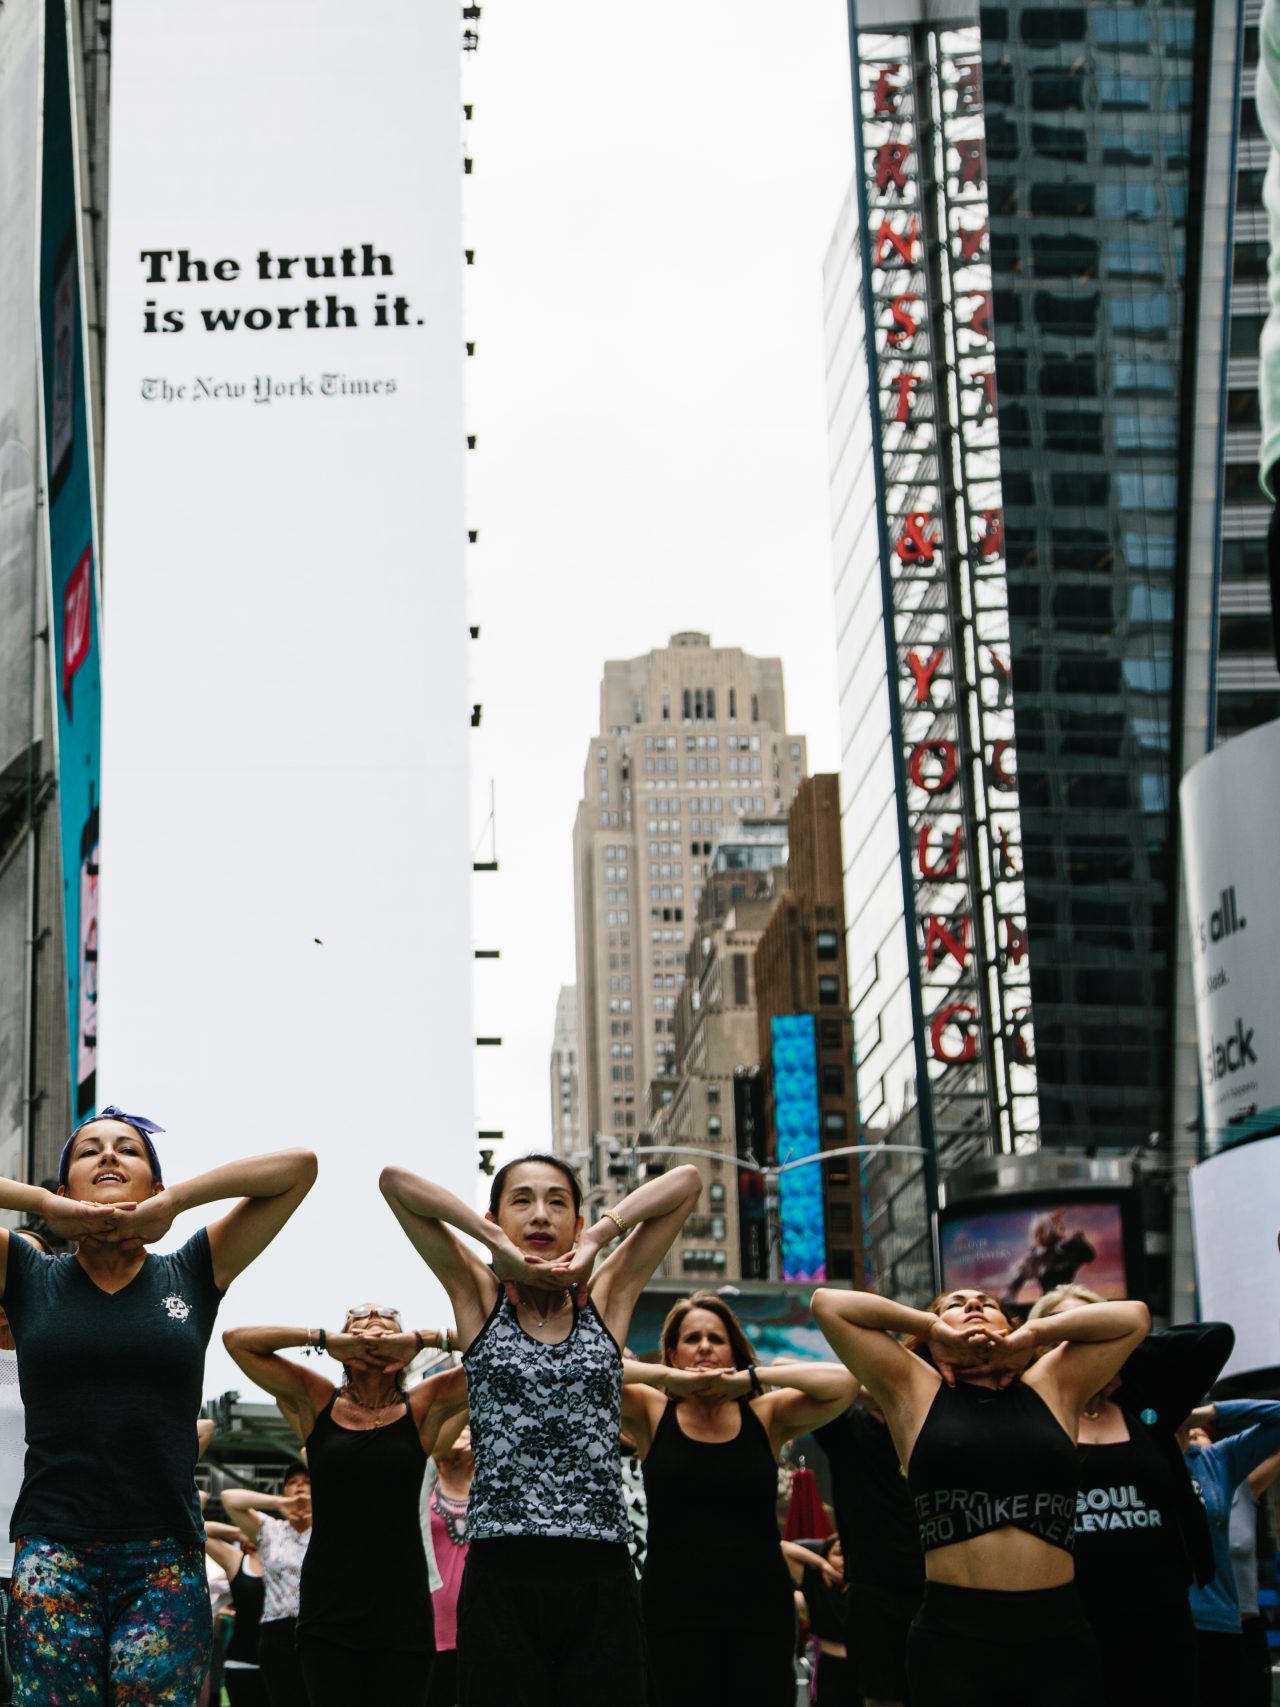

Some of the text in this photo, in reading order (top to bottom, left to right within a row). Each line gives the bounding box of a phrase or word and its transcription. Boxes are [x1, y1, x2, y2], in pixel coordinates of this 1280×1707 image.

[874, 63, 922, 422] ERNST
[140, 244, 394, 283] The truth
[143, 294, 425, 333] is worth it.
[140, 372, 398, 403] The New York Times
[907, 649, 978, 1064] YOUNG
[965, 1494, 1030, 1533] NIKE
[1076, 1485, 1146, 1512] SOUL
